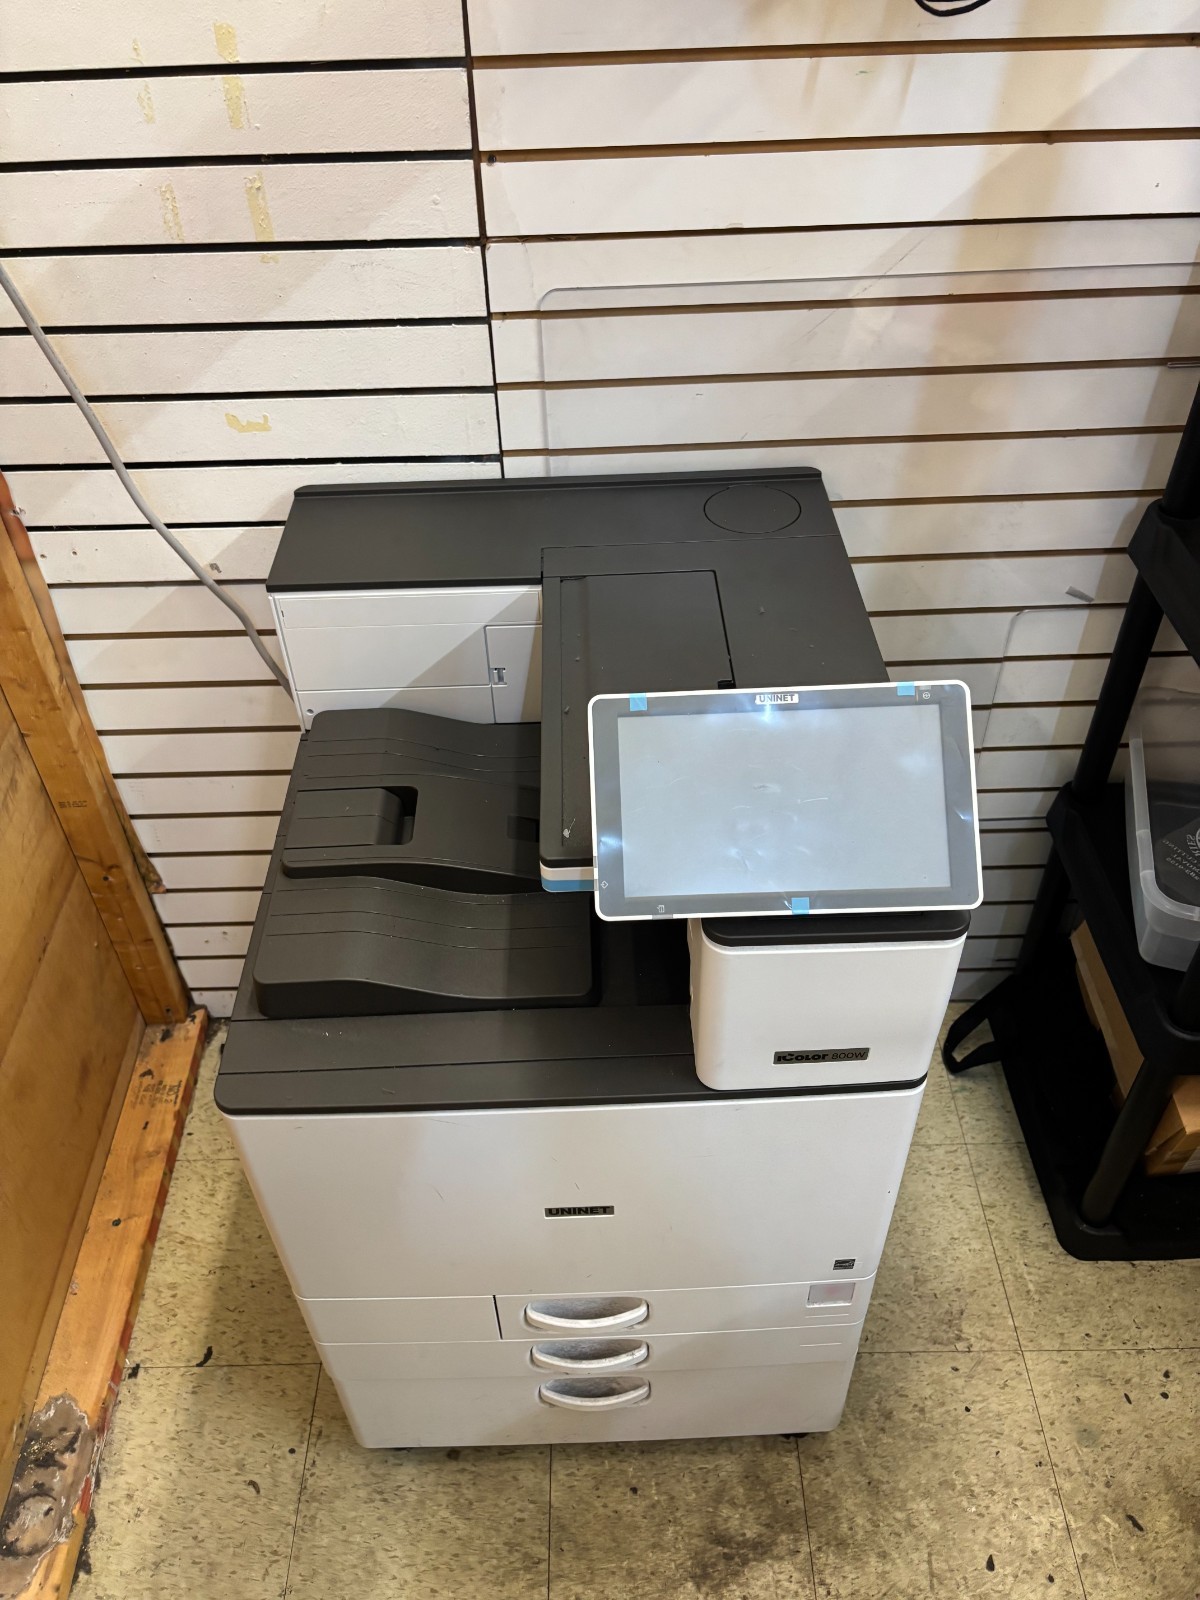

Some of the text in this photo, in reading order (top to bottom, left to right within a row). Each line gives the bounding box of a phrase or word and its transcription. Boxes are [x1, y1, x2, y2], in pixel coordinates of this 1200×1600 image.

[758, 693, 795, 703] UNINET
[831, 1051, 866, 1060] 800W
[548, 1206, 611, 1216] UNINET
